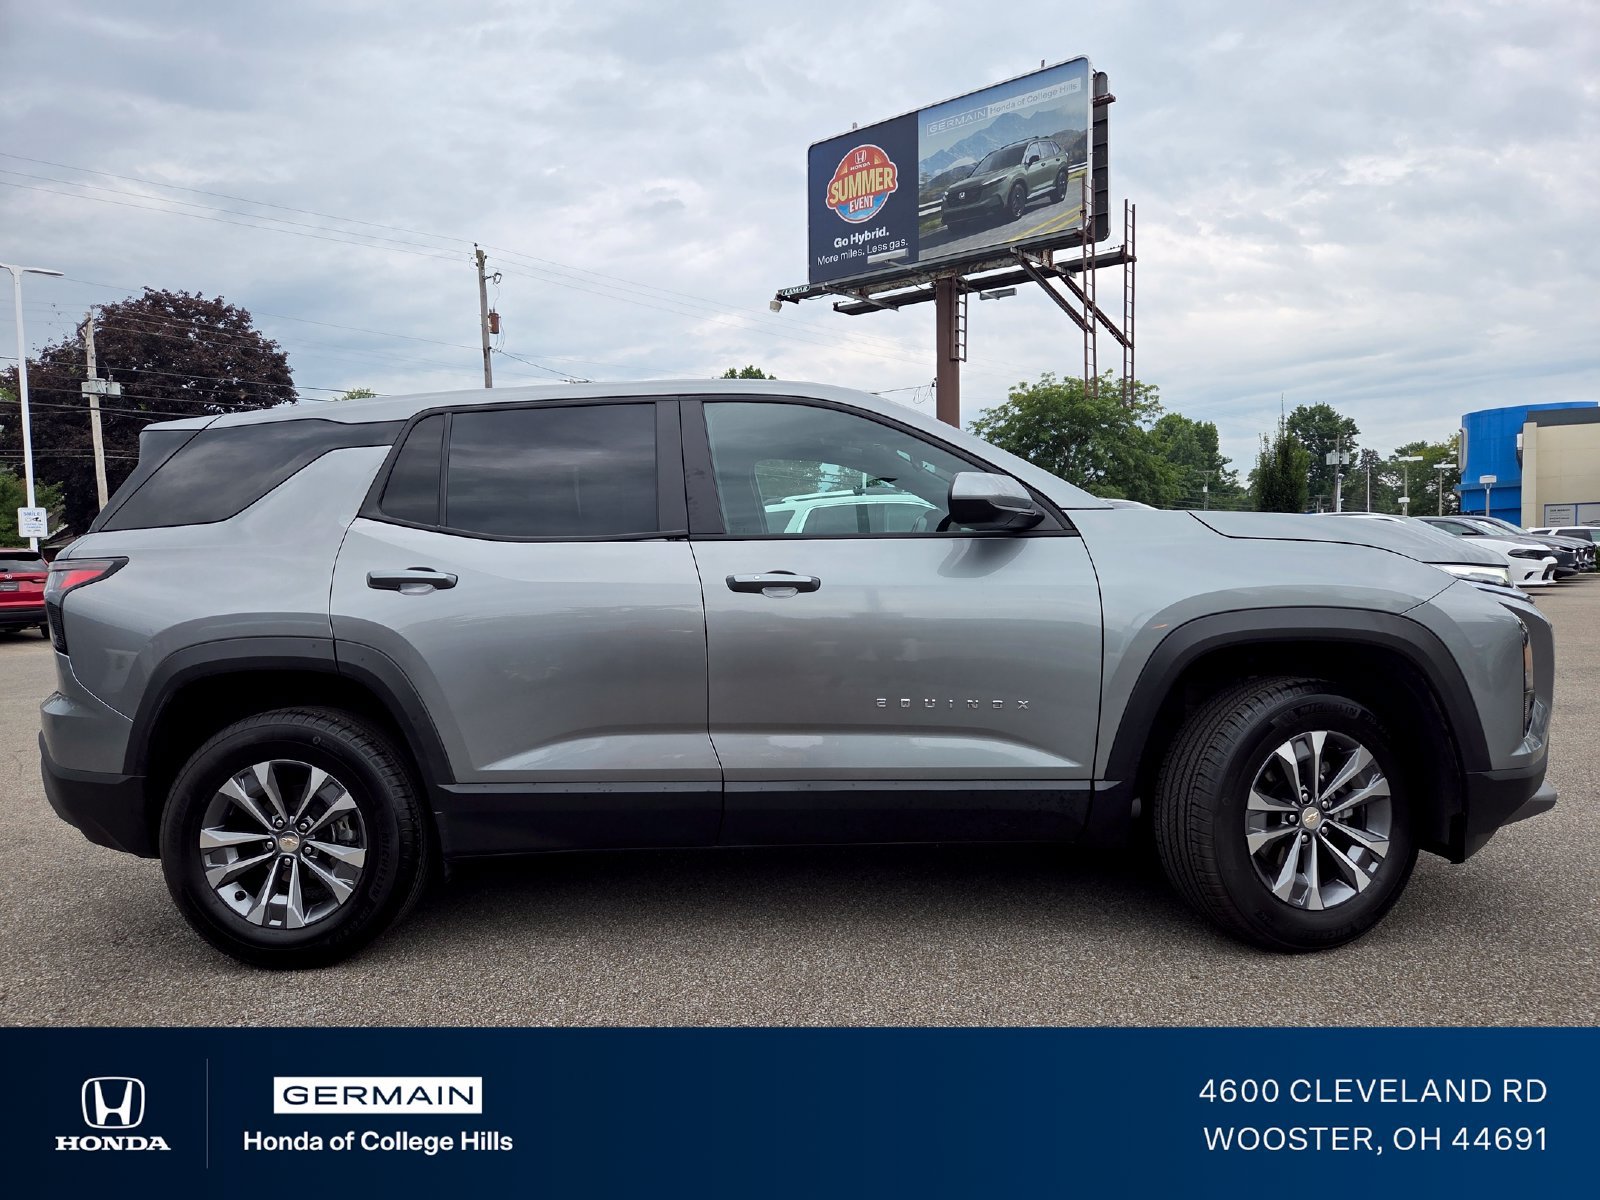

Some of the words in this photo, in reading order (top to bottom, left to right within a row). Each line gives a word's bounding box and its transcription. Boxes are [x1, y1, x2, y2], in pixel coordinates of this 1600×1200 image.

[929, 109, 986, 133] GERMAIN
[990, 102, 1016, 114] Honda
[1018, 98, 1026, 106] of
[1027, 89, 1058, 103] College
[1059, 83, 1078, 94] Hills
[850, 161, 871, 171] HONDA
[830, 168, 894, 204] SUMMER
[849, 195, 874, 213] EVENT
[833, 238, 849, 248] Go
[850, 226, 890, 245] Hybrid.
[817, 254, 838, 266] More
[841, 248, 865, 260] miles.
[867, 243, 888, 254] Less
[889, 238, 909, 250] gas.
[784, 285, 808, 295] LAMAR
[876, 698, 1029, 709] EQUINOX
